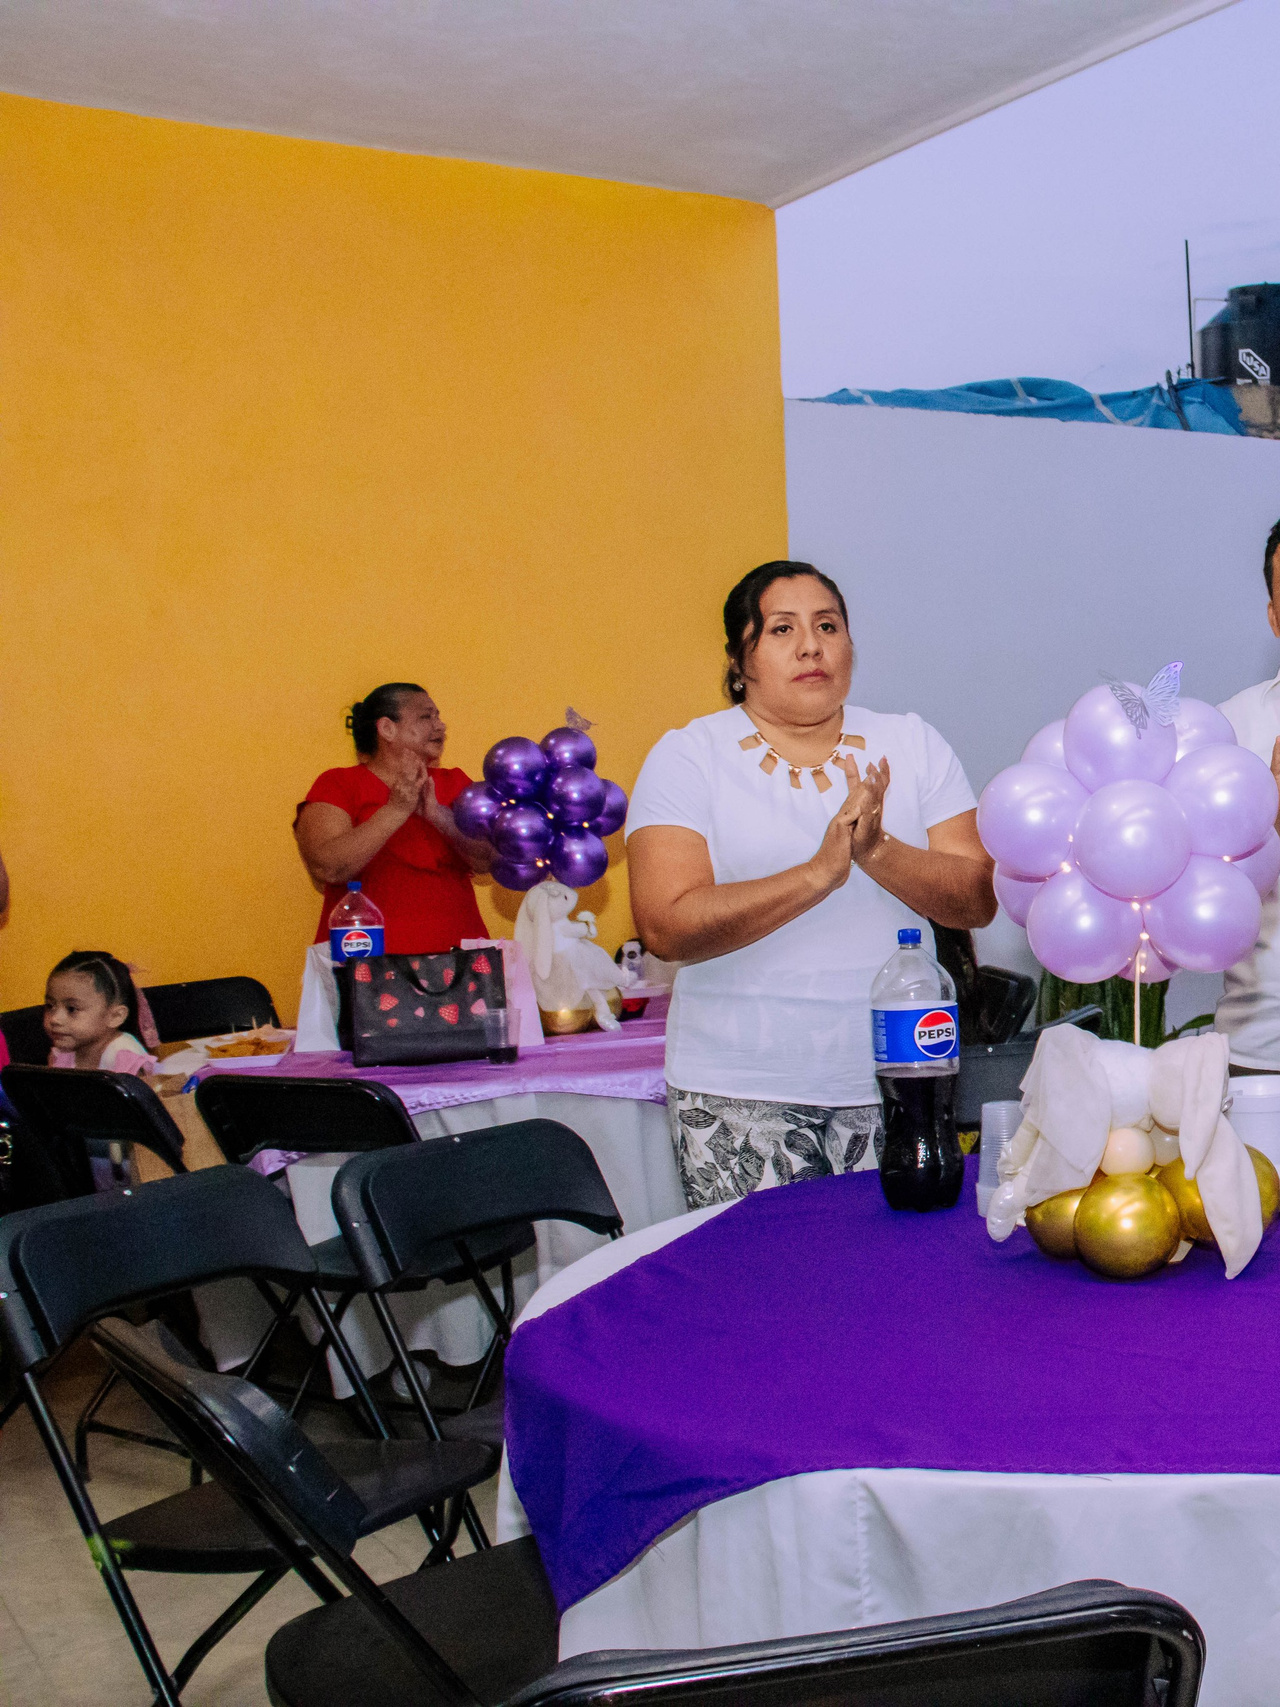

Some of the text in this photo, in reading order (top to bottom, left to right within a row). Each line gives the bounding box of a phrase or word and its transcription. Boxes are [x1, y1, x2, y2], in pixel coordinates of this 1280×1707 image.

[1242, 352, 1267, 376] IUSA
[344, 941, 370, 949] PEPSI
[918, 1027, 955, 1040] PEPSI
